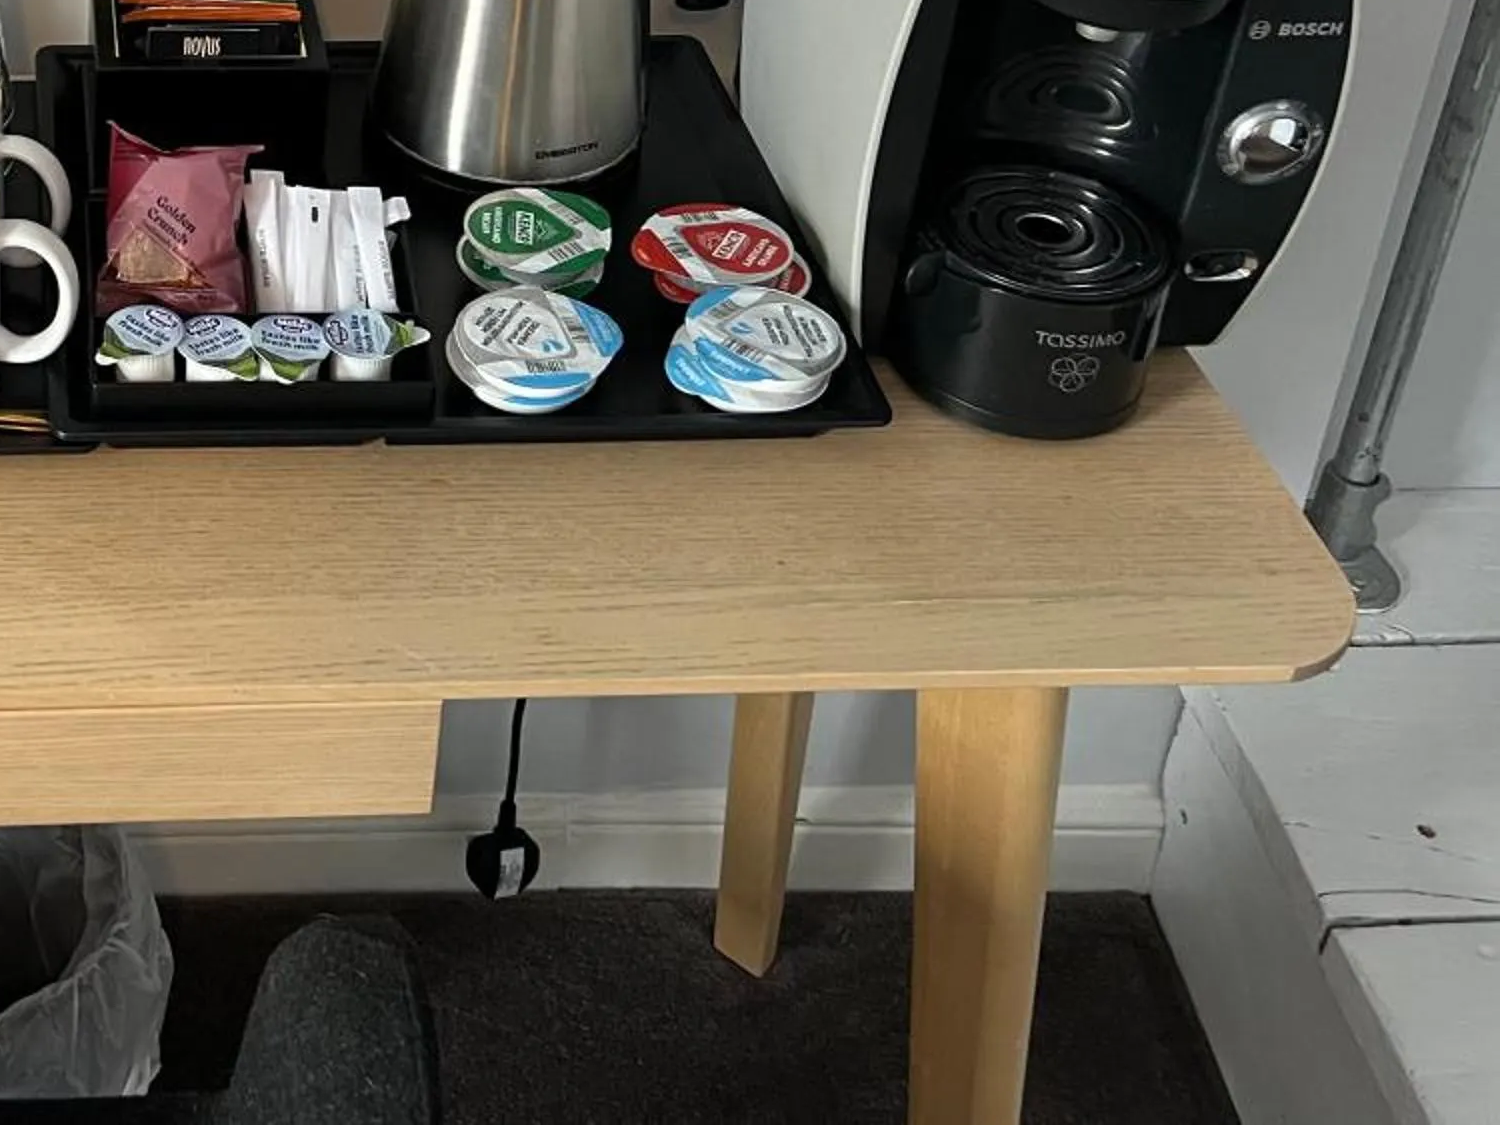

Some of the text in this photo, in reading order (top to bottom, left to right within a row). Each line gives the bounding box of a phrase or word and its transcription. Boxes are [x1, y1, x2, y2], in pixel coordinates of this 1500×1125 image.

[1278, 21, 1345, 36] BOSCH
[146, 206, 188, 246] Crunch
[156, 194, 197, 234] Golden
